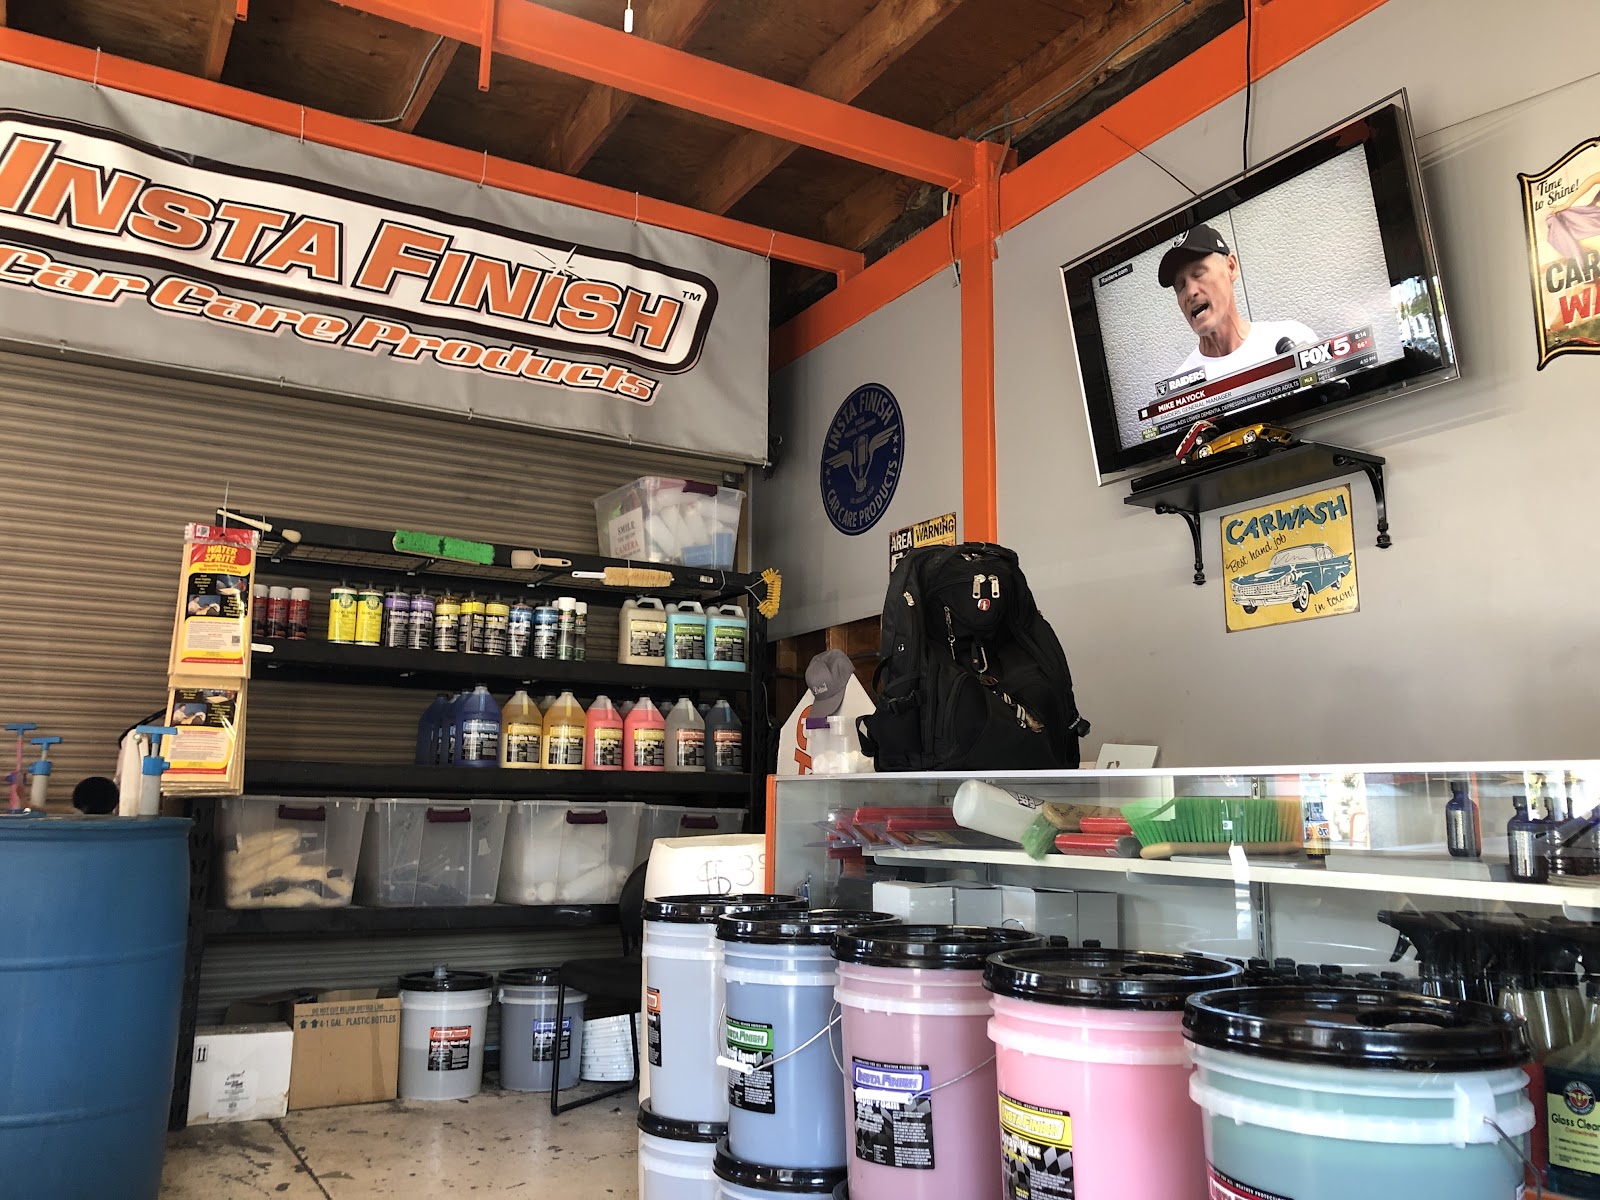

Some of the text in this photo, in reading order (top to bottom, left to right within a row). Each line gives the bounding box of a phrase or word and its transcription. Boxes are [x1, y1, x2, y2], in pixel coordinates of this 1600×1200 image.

[1535, 179, 1579, 211] to Shine!
[1537, 178, 1563, 197] Time
[0, 133, 344, 283] INSTA
[354, 218, 686, 353] FINISH
[1545, 249, 1600, 293] CAR
[1559, 283, 1600, 325] W
[0, 246, 661, 405] Car Care Products
[1355, 331, 1366, 340] 8:14
[1299, 336, 1350, 369] FOX 5
[1168, 370, 1205, 391] RAIDERS
[1257, 392, 1266, 400] FOR
[1267, 387, 1281, 396] OLDER
[1282, 381, 1299, 391] ADULTS
[1158, 390, 1206, 412] MIKE MAYOCK
[1160, 392, 1232, 420] RAIDERS GENERAL MANAGER
[827, 401, 858, 451] INSTA
[859, 391, 896, 426] FINISH
[827, 488, 840, 514] CAR
[838, 508, 857, 527] CARE
[859, 460, 898, 525] PRODUCTS
[617, 521, 635, 535] SMILE
[1225, 494, 1348, 546] CARWASH
[207, 545, 238, 555] WATER
[615, 540, 639, 555] CAMERA
[890, 531, 913, 553] AREA
[204, 553, 237, 563] SPRITE
[1227, 533, 1287, 573] Best hand job
[1314, 601, 1326, 614] in
[346, 1016, 370, 1025] PLASTIC
[371, 1014, 396, 1025] BOTTLES
[737, 1049, 757, 1065] Agent
[1551, 1113, 1575, 1127] Glass
[1020, 1139, 1042, 1160] Wax
